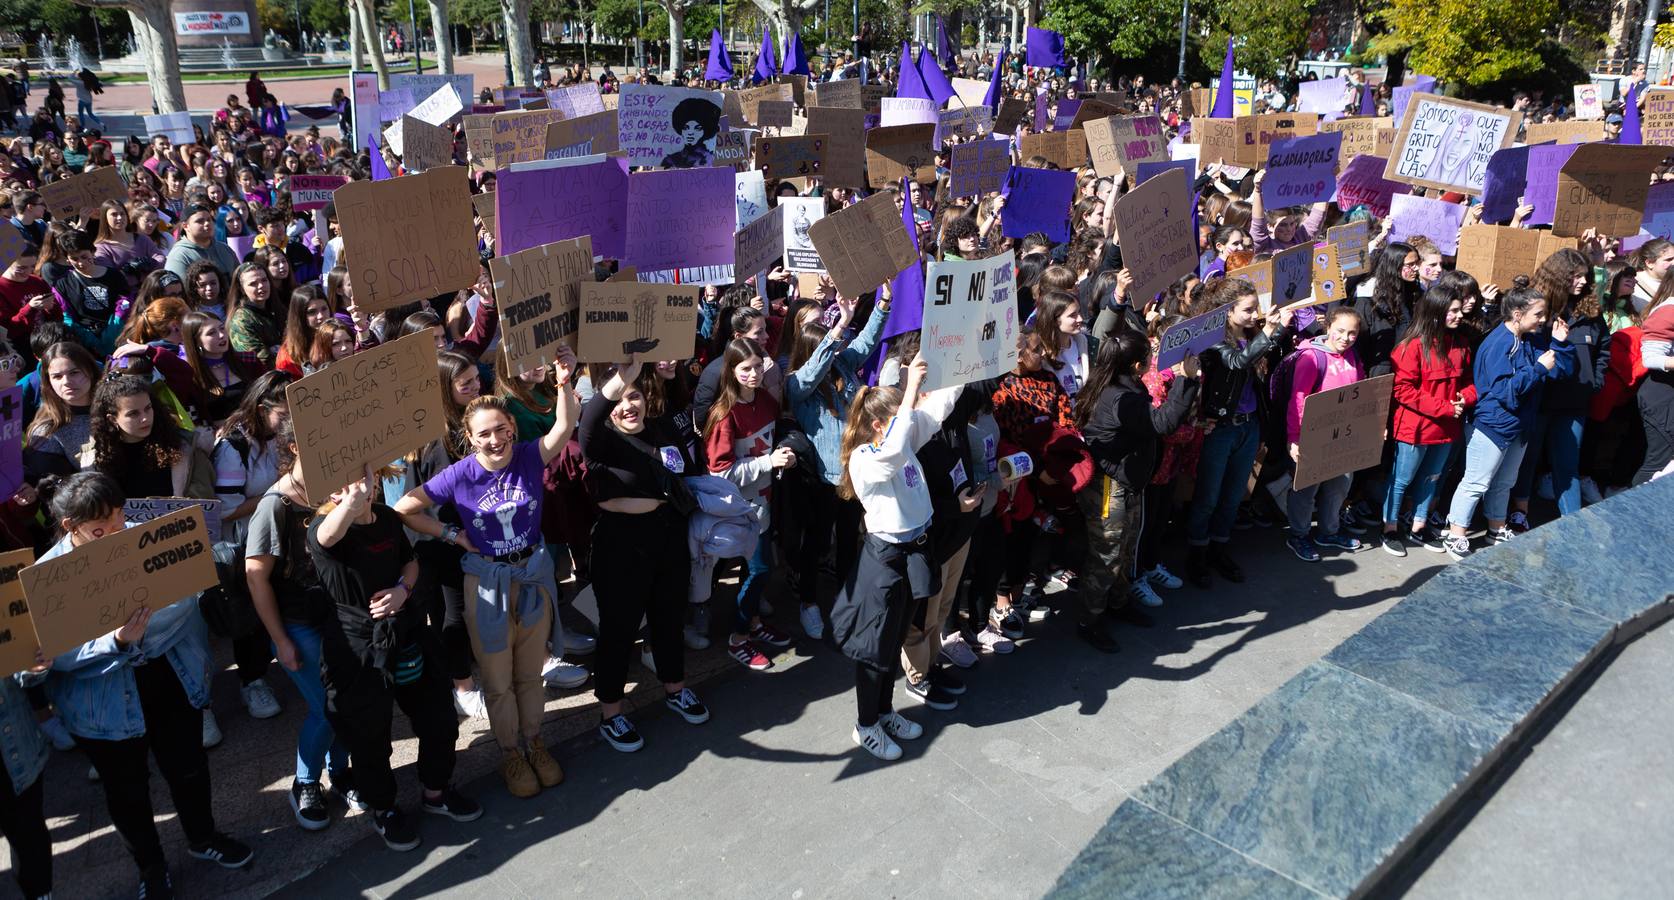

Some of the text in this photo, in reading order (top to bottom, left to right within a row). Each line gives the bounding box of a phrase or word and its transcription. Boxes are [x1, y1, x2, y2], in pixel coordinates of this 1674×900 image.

[1414, 119, 1428, 131] EL
[1419, 102, 1456, 125] SOMOS
[1477, 115, 1502, 132] QUE
[635, 132, 648, 142] NO
[1409, 132, 1442, 150] GRITO
[1477, 142, 1494, 153] NO
[1480, 129, 1494, 143] YA
[1406, 148, 1420, 164] DE
[1399, 161, 1427, 179] LAS
[393, 223, 421, 253] NO
[387, 253, 441, 298] SOLA
[508, 263, 535, 302] NO
[537, 258, 554, 289] SE
[934, 274, 954, 306] SI
[967, 270, 986, 302] NO
[504, 292, 553, 328] TRATOS
[666, 295, 694, 308] ROSAS
[585, 310, 629, 324] HERMANA
[982, 320, 997, 341] POR
[507, 331, 532, 361] QUE
[293, 352, 398, 412] POR MI CLASE
[321, 378, 379, 418] OBRERA
[307, 375, 439, 448] EL HONOR DE LAS
[318, 418, 407, 481] HERMANAS
[31, 554, 90, 593] HASTA
[105, 543, 130, 565] LOS
[138, 515, 197, 550] OVARIOS
[43, 593, 65, 617] DE
[81, 566, 139, 600] TANTOS
[100, 600, 127, 626] 8M
